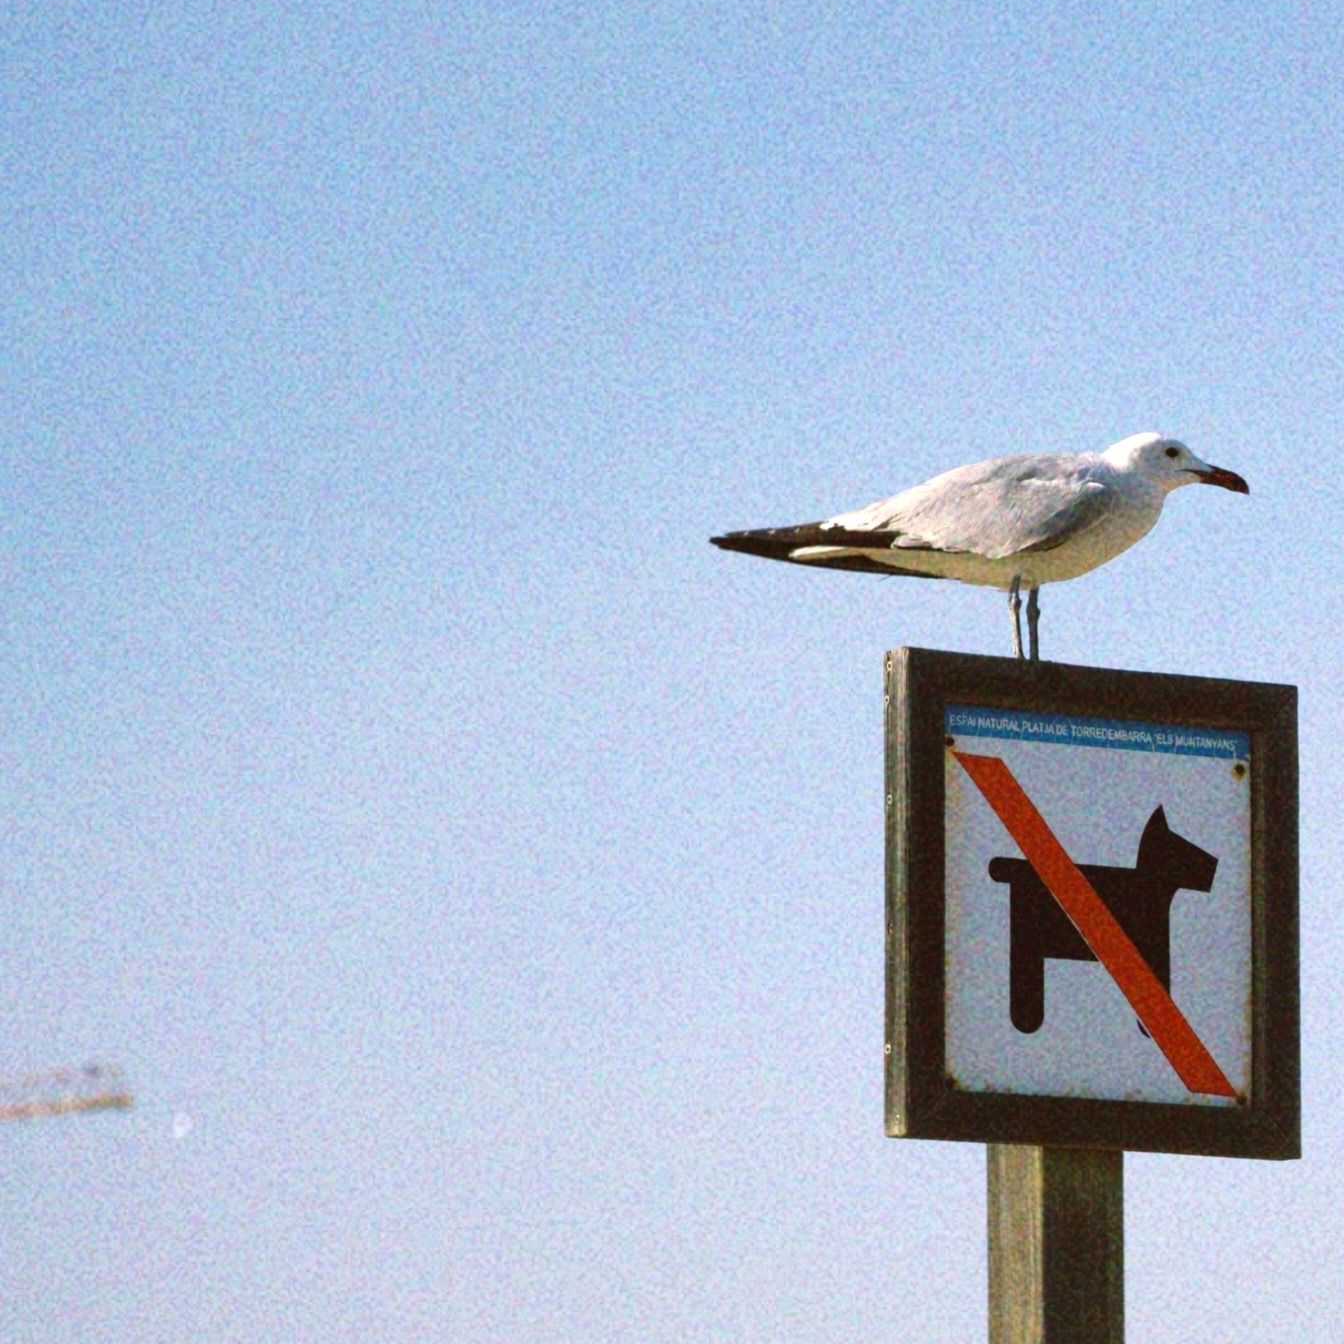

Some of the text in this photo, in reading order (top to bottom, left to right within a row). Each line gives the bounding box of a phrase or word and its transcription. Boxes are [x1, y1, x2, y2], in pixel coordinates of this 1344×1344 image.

[949, 714, 976, 727] ESPAI
[978, 717, 1020, 732] NATURAL
[1021, 721, 1055, 735] PLATJA
[1055, 724, 1068, 736] DE
[1071, 725, 1152, 743] TORREDEMBARRA
